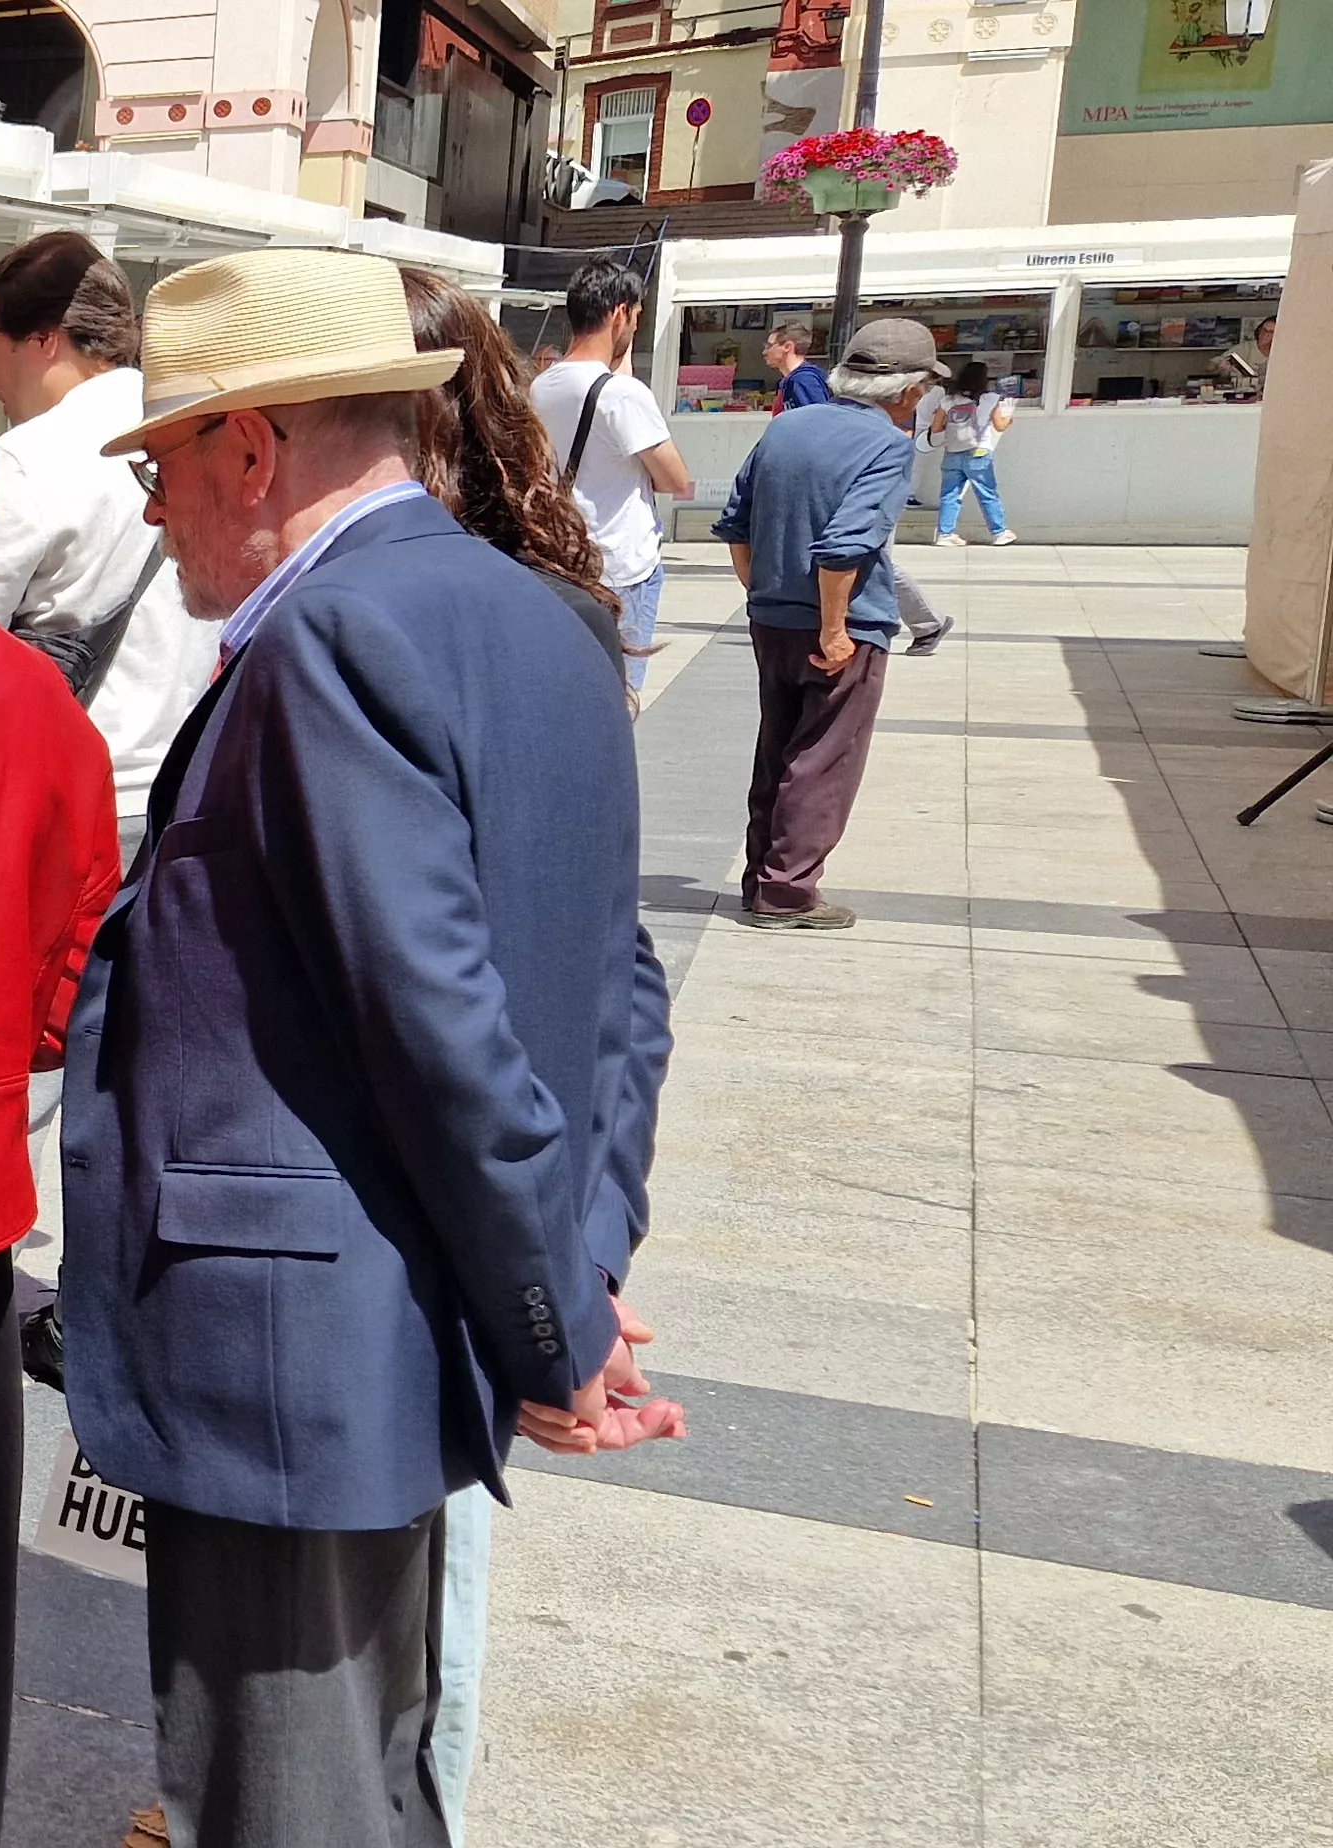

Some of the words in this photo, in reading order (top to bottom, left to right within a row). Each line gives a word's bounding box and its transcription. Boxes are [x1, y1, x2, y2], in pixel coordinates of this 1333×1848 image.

[1083, 106, 1129, 123] MPA
[1079, 252, 1115, 265] Estilo
[58, 1480, 146, 1552] HUE
